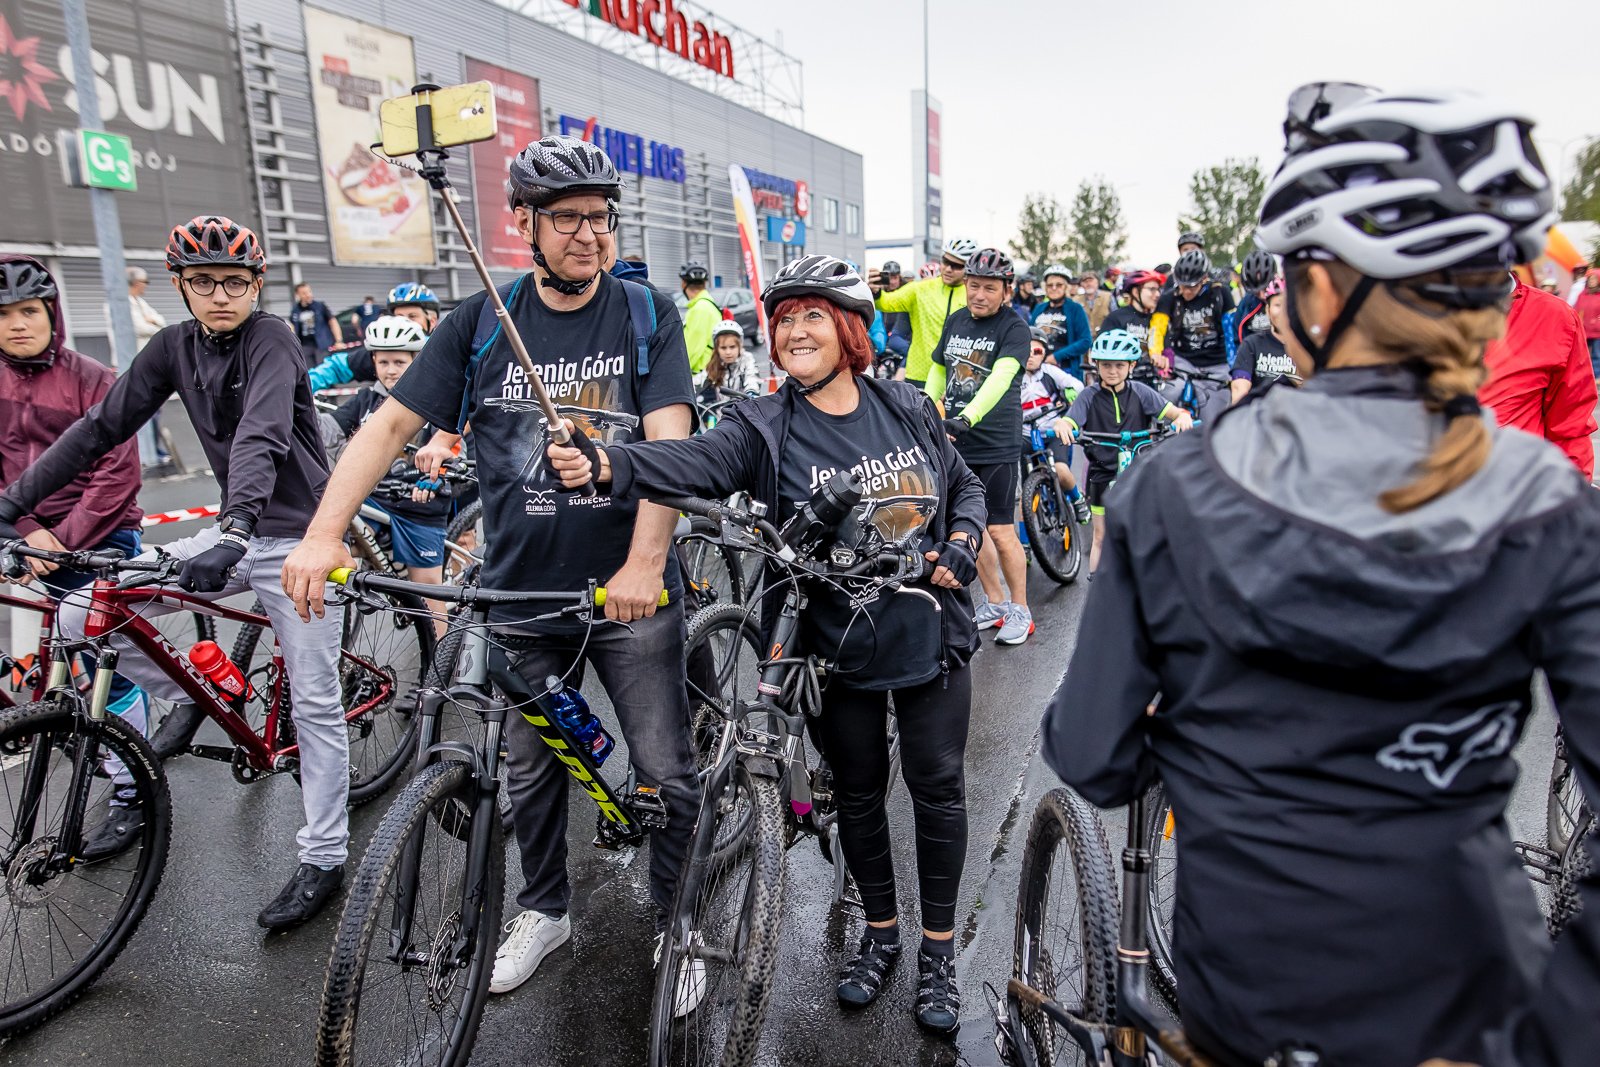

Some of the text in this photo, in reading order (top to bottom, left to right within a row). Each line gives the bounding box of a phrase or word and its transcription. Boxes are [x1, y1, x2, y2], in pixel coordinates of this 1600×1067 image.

[57, 45, 225, 144] SUN
[604, 127, 686, 184] HELIOS
[972, 337, 996, 352] Góra
[1257, 352, 1293, 365] Jelenia
[581, 351, 625, 380] Góra
[1268, 364, 1297, 374] rowery
[502, 384, 523, 400] na
[527, 380, 584, 401] rwery
[810, 455, 886, 489] Jenia
[525, 504, 543, 512] JELENIA
[152, 634, 231, 713] KROSS
[128, 742, 158, 780] RAPID
